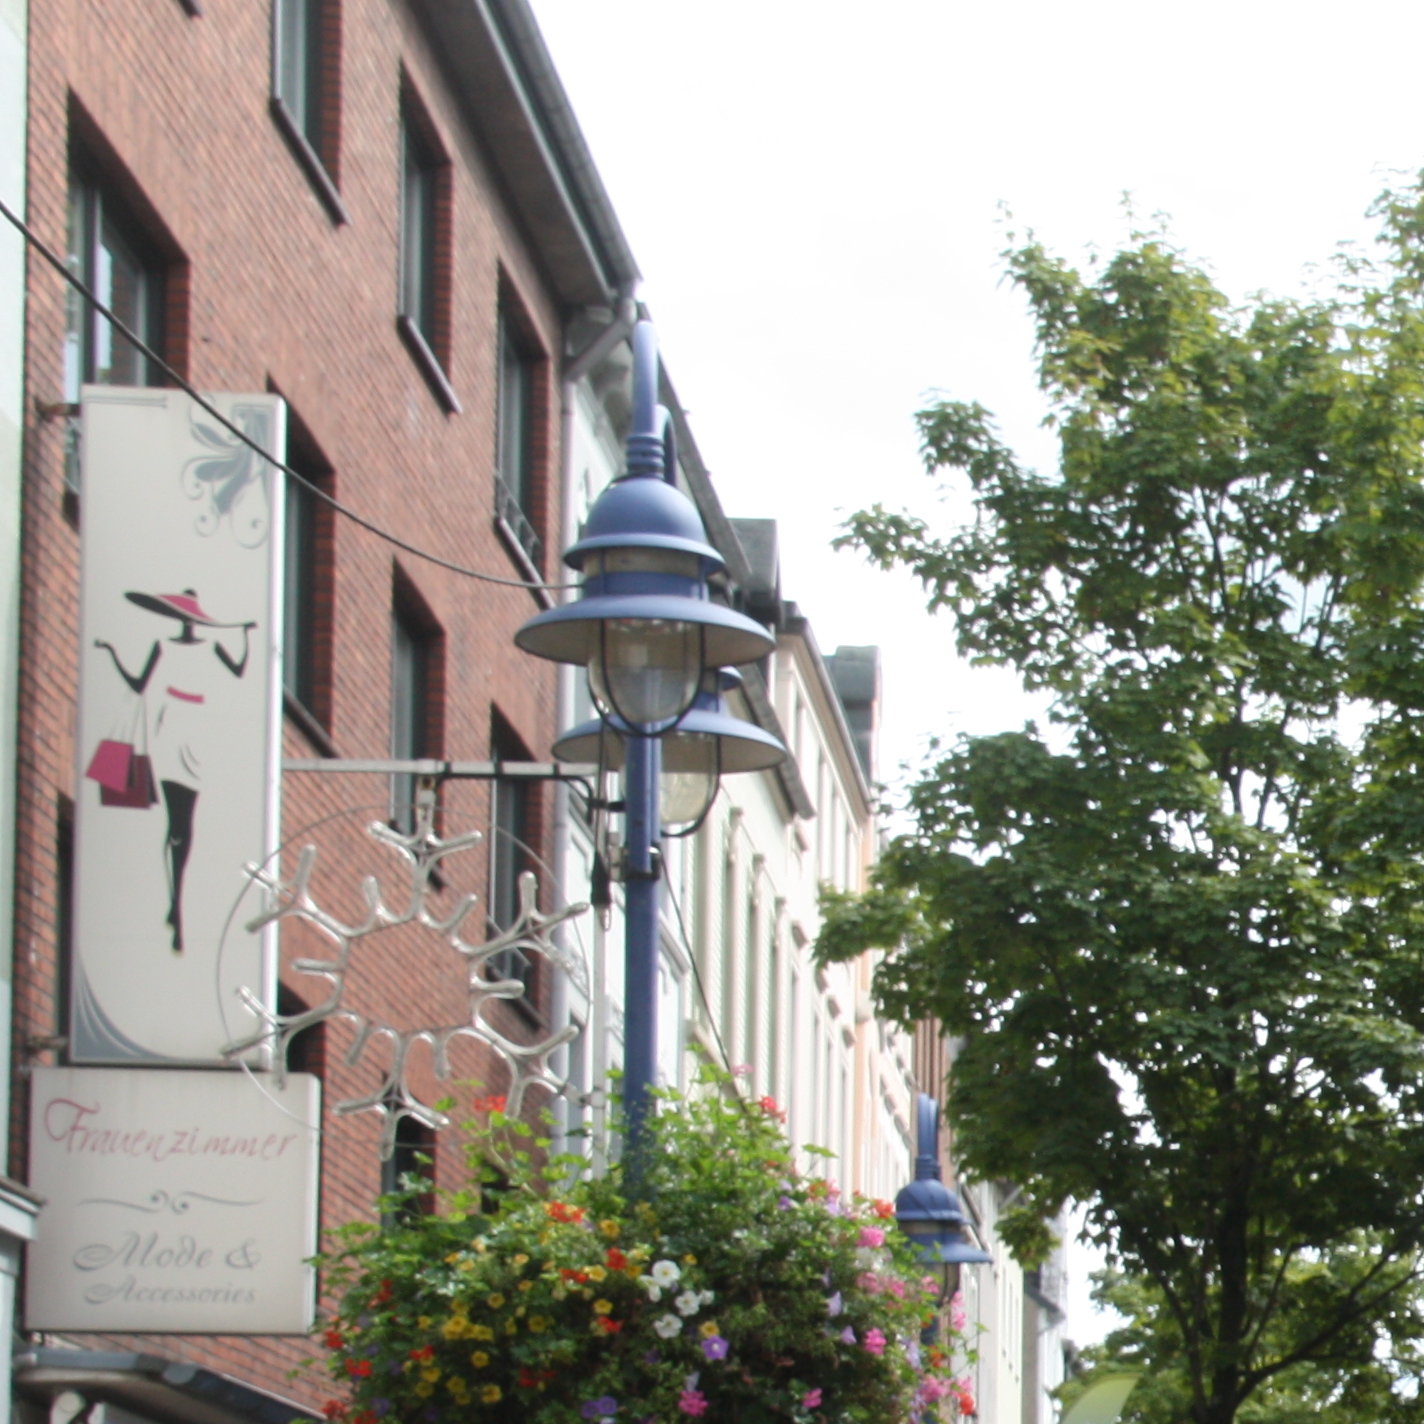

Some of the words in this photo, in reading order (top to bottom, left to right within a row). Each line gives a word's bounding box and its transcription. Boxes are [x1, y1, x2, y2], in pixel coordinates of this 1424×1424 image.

[44, 1098, 298, 1162] Frauenzimmer
[73, 1232, 215, 1272] Mode
[224, 1239, 261, 1270] &
[84, 1276, 257, 1305] Accessories
